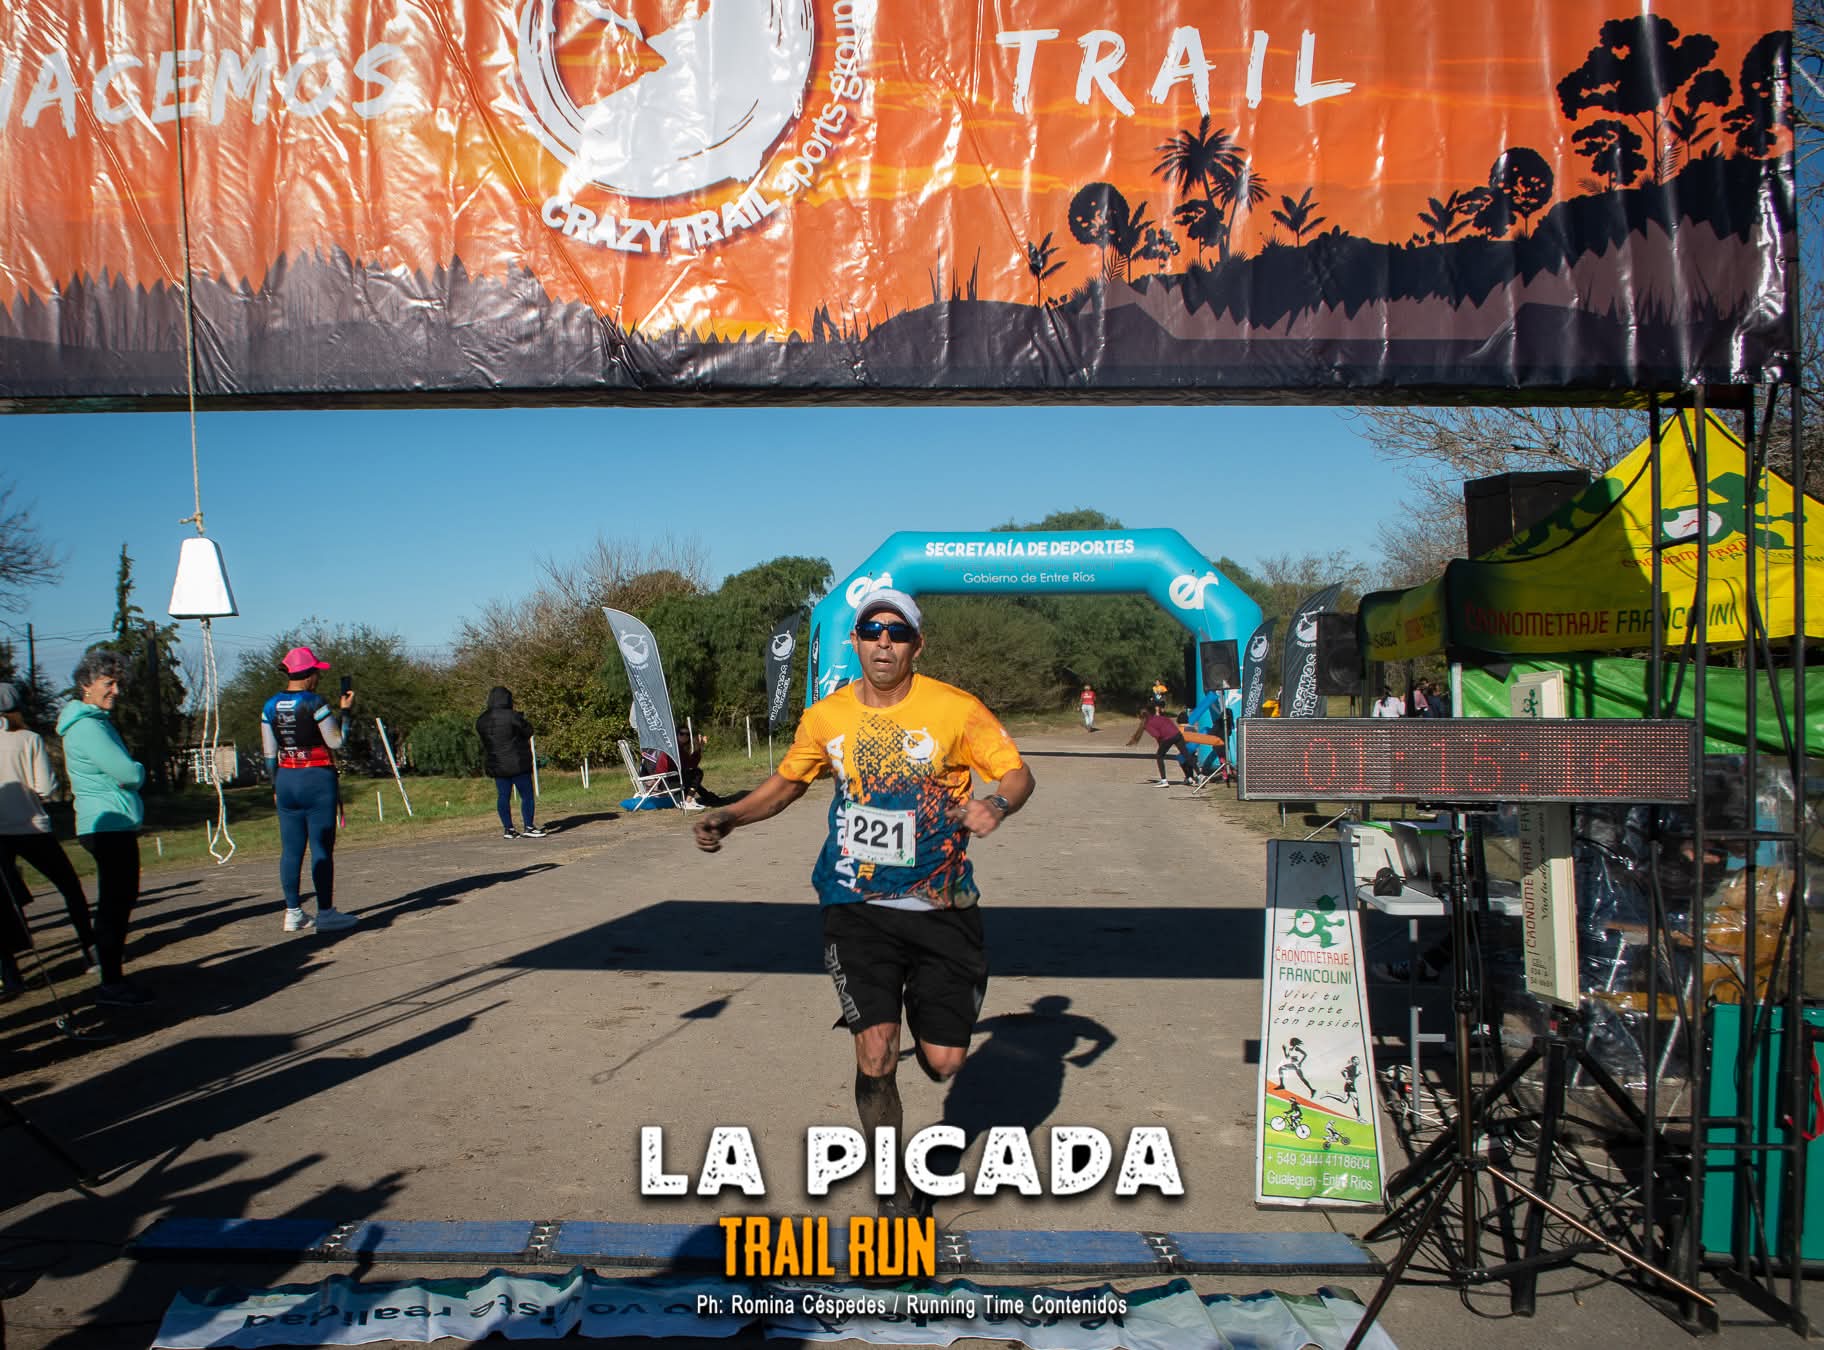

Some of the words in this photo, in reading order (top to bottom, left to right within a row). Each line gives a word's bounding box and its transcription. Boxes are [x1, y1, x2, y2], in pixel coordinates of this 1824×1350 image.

[995, 26, 1357, 118] TRAIL
[774, 102, 847, 197] sports
[925, 538, 1026, 557] SECRETARÍA
[1027, 541, 1047, 557] DE
[1051, 539, 1135, 556] DEPORTES
[963, 573, 1018, 584] Gobierno
[1021, 573, 1037, 583] de
[1040, 573, 1069, 583] Entre
[1072, 571, 1096, 583] Ríos
[1464, 606, 1609, 638] CRONOMETRAJE
[853, 815, 905, 849] 221
[1275, 948, 1350, 966] CRONOMETRAJE
[1279, 966, 1352, 984] FRANCOLINI
[1323, 993, 1341, 1001] tu
[1273, 1017, 1299, 1025] con
[1306, 1019, 1360, 1028] pasión
[1277, 1152, 1296, 1165] 549
[1326, 1155, 1370, 1170] 4118604
[1267, 1170, 1316, 1190] Gualeguay
[1351, 1175, 1373, 1191] Ríos
